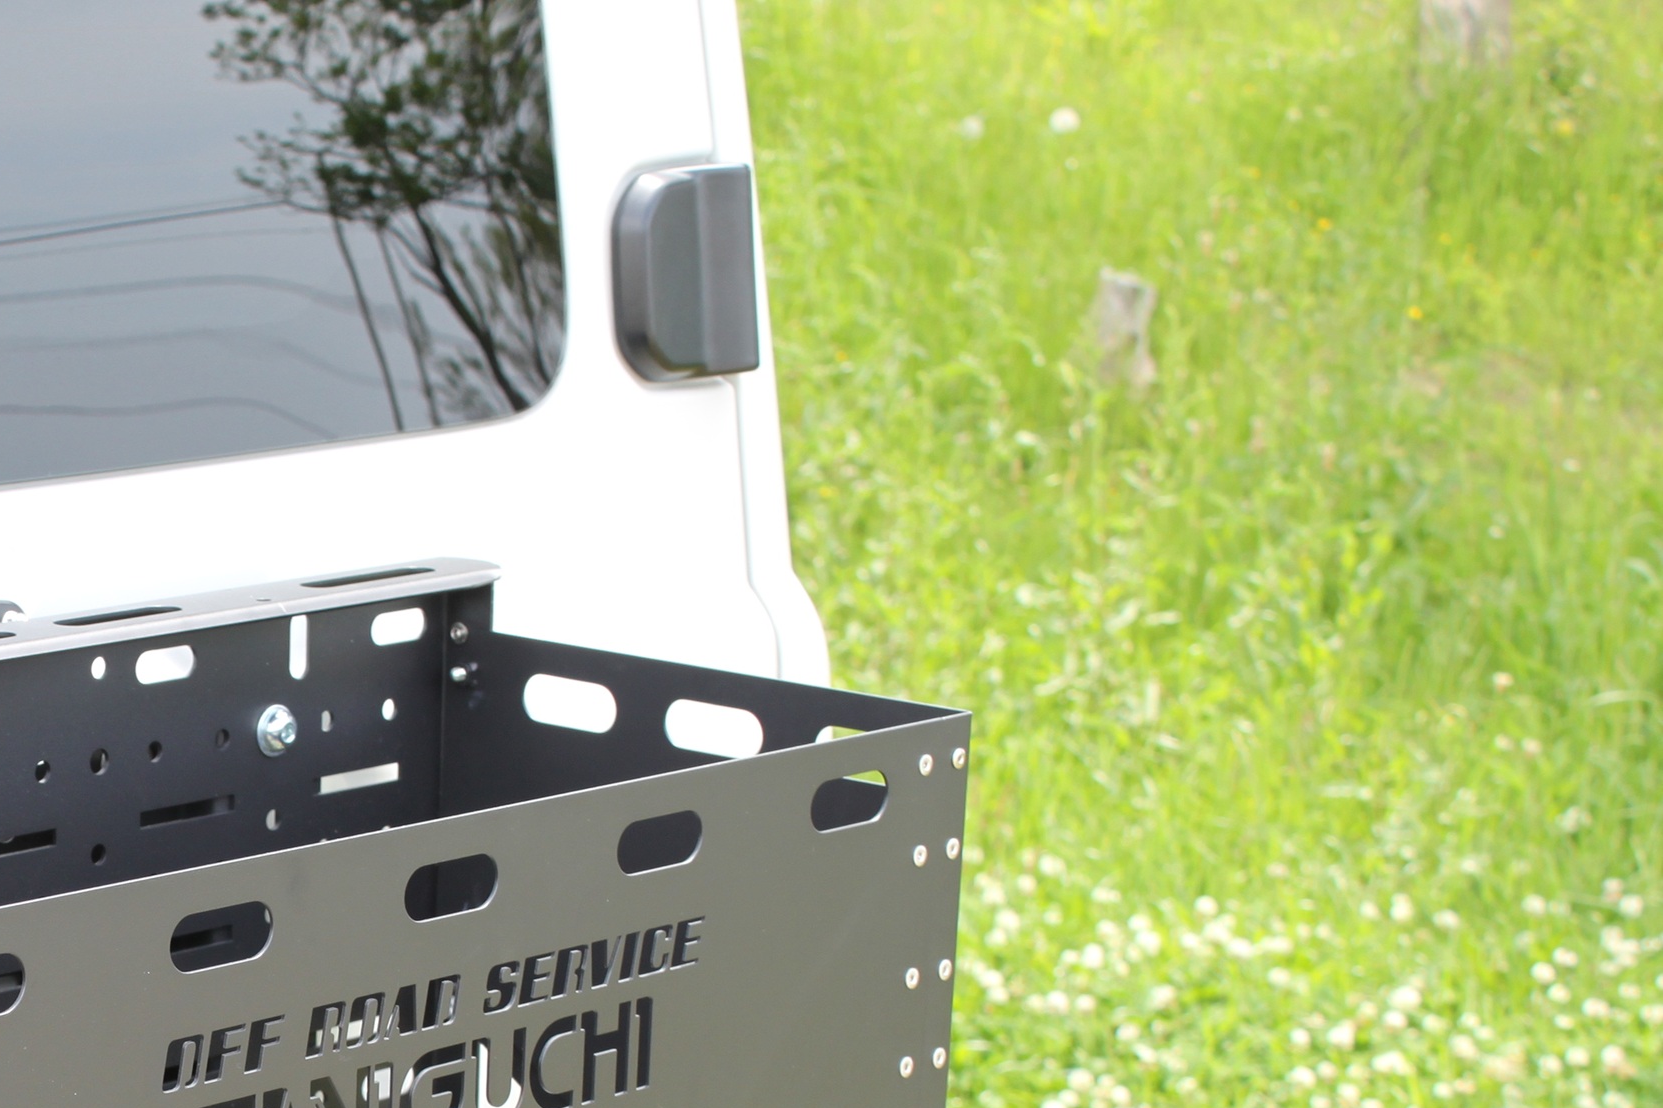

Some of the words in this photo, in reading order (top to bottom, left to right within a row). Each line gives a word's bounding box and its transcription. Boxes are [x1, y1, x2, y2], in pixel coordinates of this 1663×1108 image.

[161, 1014, 285, 1094] OFF
[304, 973, 461, 1060] ROAD
[483, 915, 706, 1016] SERVICE
